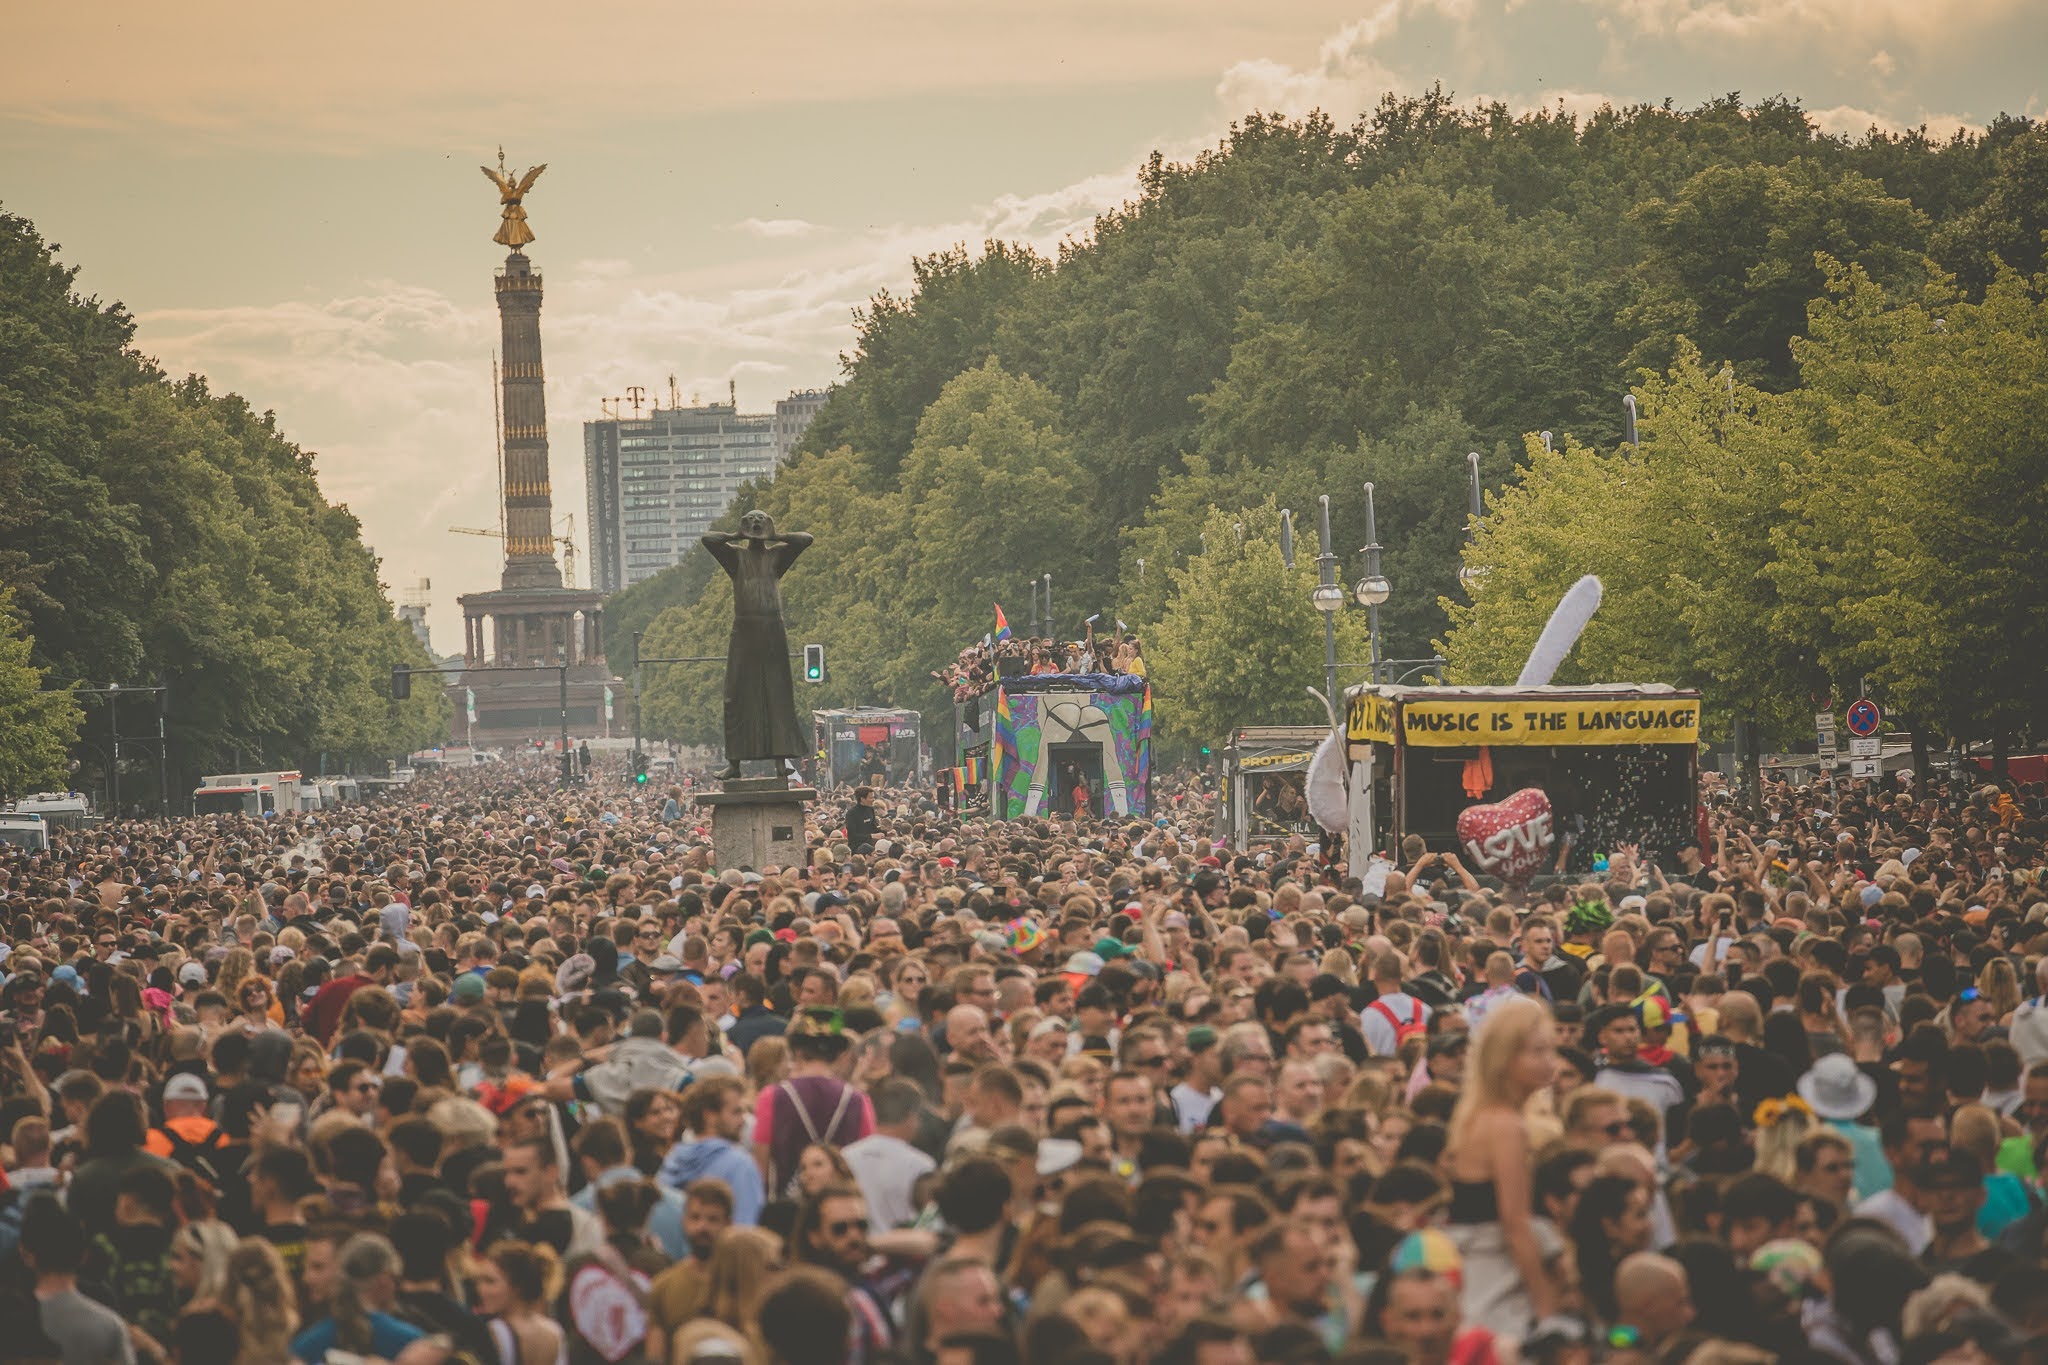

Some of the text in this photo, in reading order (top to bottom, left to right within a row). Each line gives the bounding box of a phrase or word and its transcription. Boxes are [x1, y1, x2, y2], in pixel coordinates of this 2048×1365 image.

[627, 386, 644, 409] T
[602, 430, 611, 520] TECHNISCHE
[1408, 712, 1479, 731] MUSIC
[1492, 712, 1513, 731] IS
[1524, 712, 1567, 730] THE
[1578, 709, 1696, 730] LANGUAGE
[1241, 752, 1314, 767] PROTECT
[1466, 811, 1555, 867] LOVE
[1501, 852, 1538, 877] you
